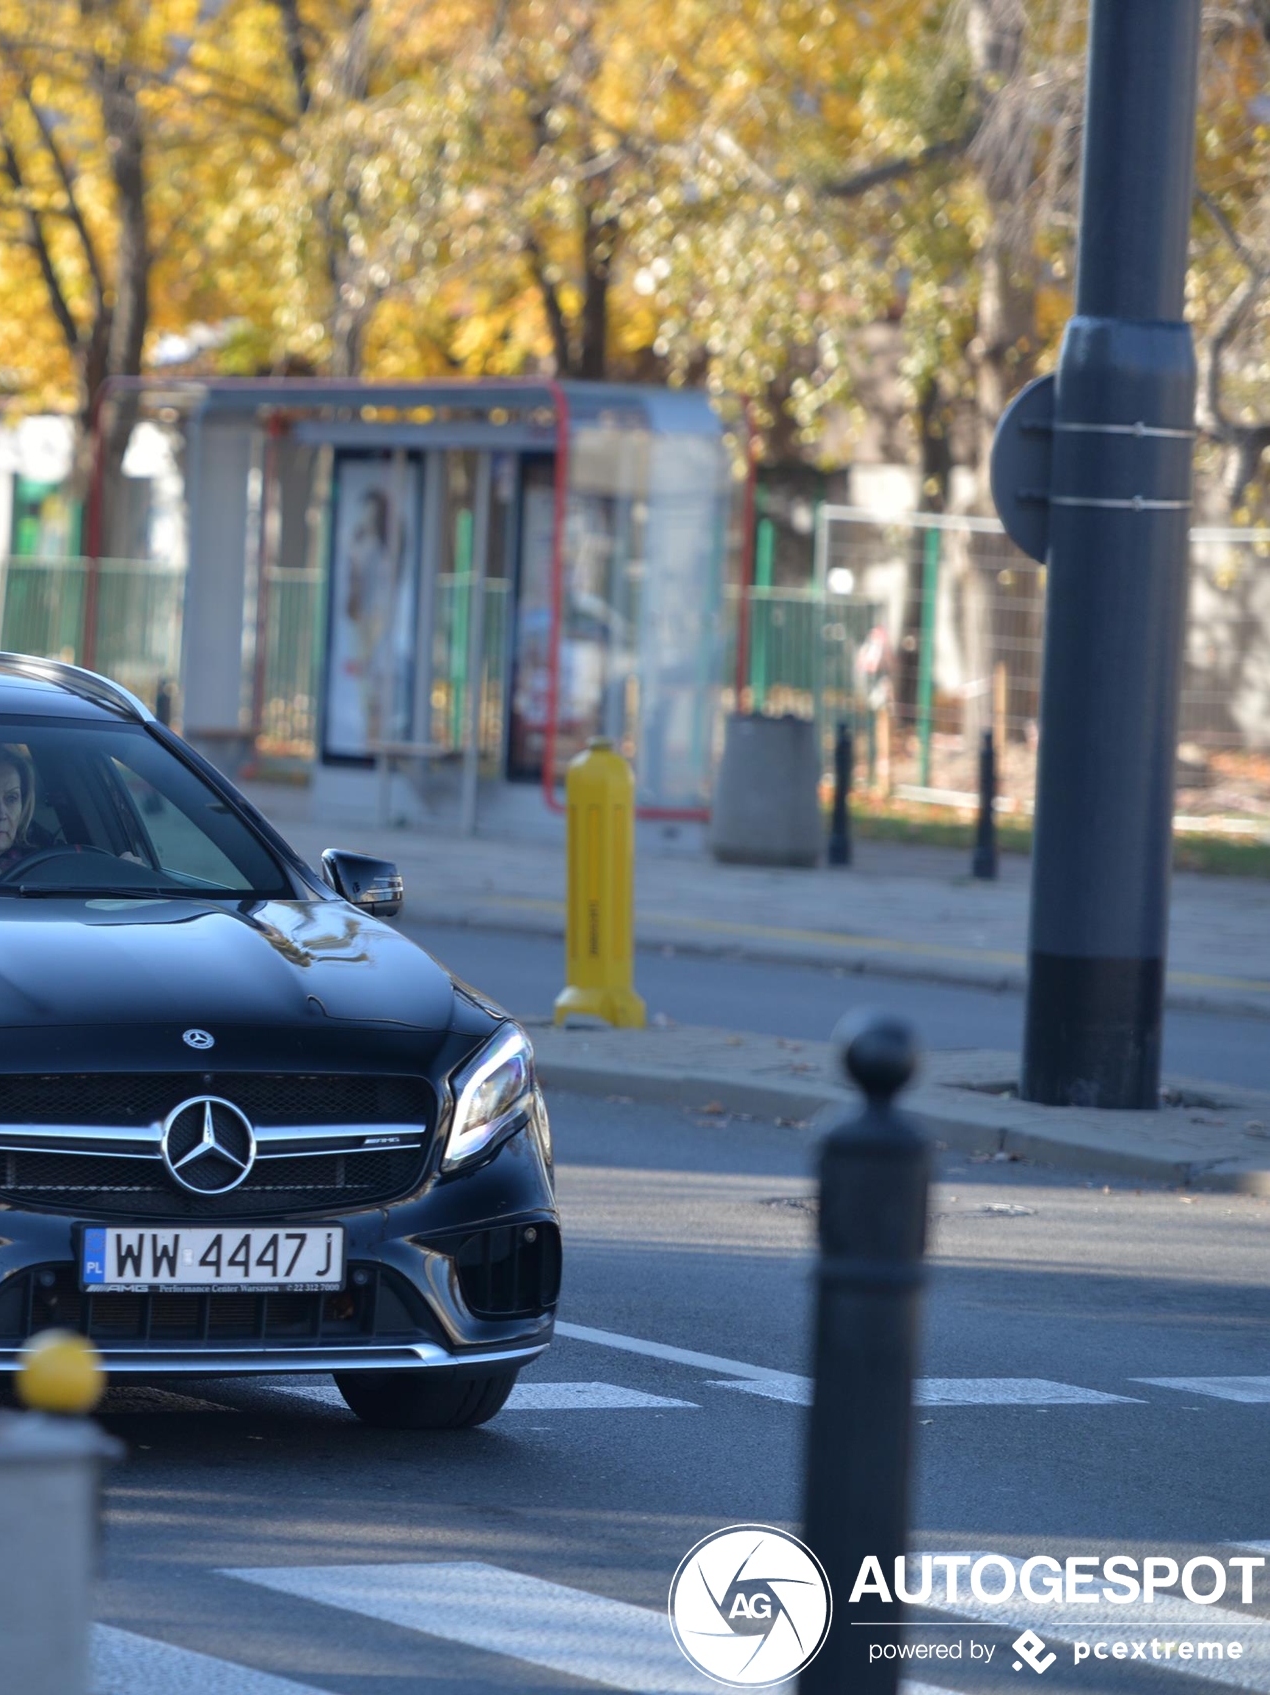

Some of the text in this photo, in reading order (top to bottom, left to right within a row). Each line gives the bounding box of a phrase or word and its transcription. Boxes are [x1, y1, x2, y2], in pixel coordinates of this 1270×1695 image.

[116, 1233, 180, 1278] WW
[86, 1261, 103, 1274] PL
[107, 1284, 149, 1293] AMG
[159, 1284, 210, 1293] Performance
[211, 1284, 239, 1293] Center
[240, 1283, 280, 1293] Warszawa
